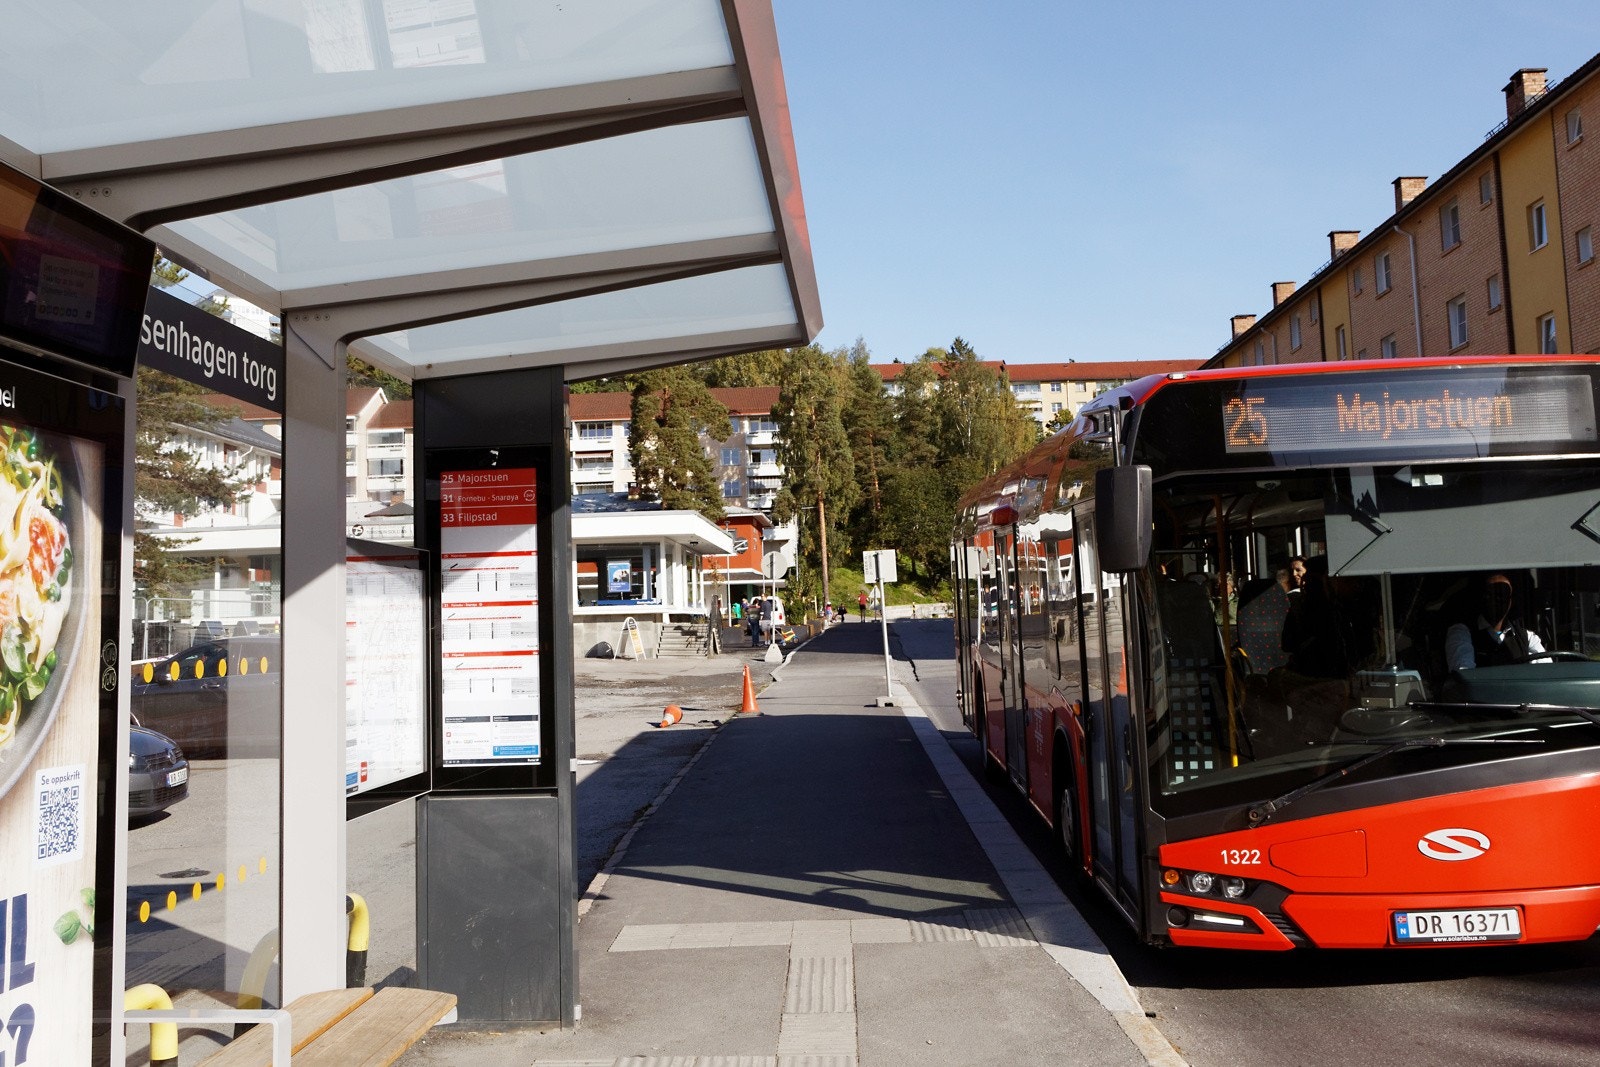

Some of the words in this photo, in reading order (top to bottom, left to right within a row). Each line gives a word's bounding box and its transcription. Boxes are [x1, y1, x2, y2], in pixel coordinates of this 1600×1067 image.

[242, 351, 276, 401] torg
[1225, 397, 1268, 445] 25
[1337, 389, 1513, 439] Majorstuen
[442, 474, 454, 484] 25
[457, 473, 509, 485] Majorstuen
[442, 494, 454, 503] 31
[457, 495, 486, 503] Fornebu
[491, 494, 519, 502] Snarøya
[442, 513, 454, 523] 33
[457, 512, 498, 523] Filipstad
[41, 775, 50, 786] Se
[51, 769, 80, 785] oppskrift
[1220, 849, 1261, 866] 1322
[1415, 915, 1443, 934] DR
[1452, 913, 1510, 933] 16371
[1432, 935, 1487, 943] www.solarisbus.no
